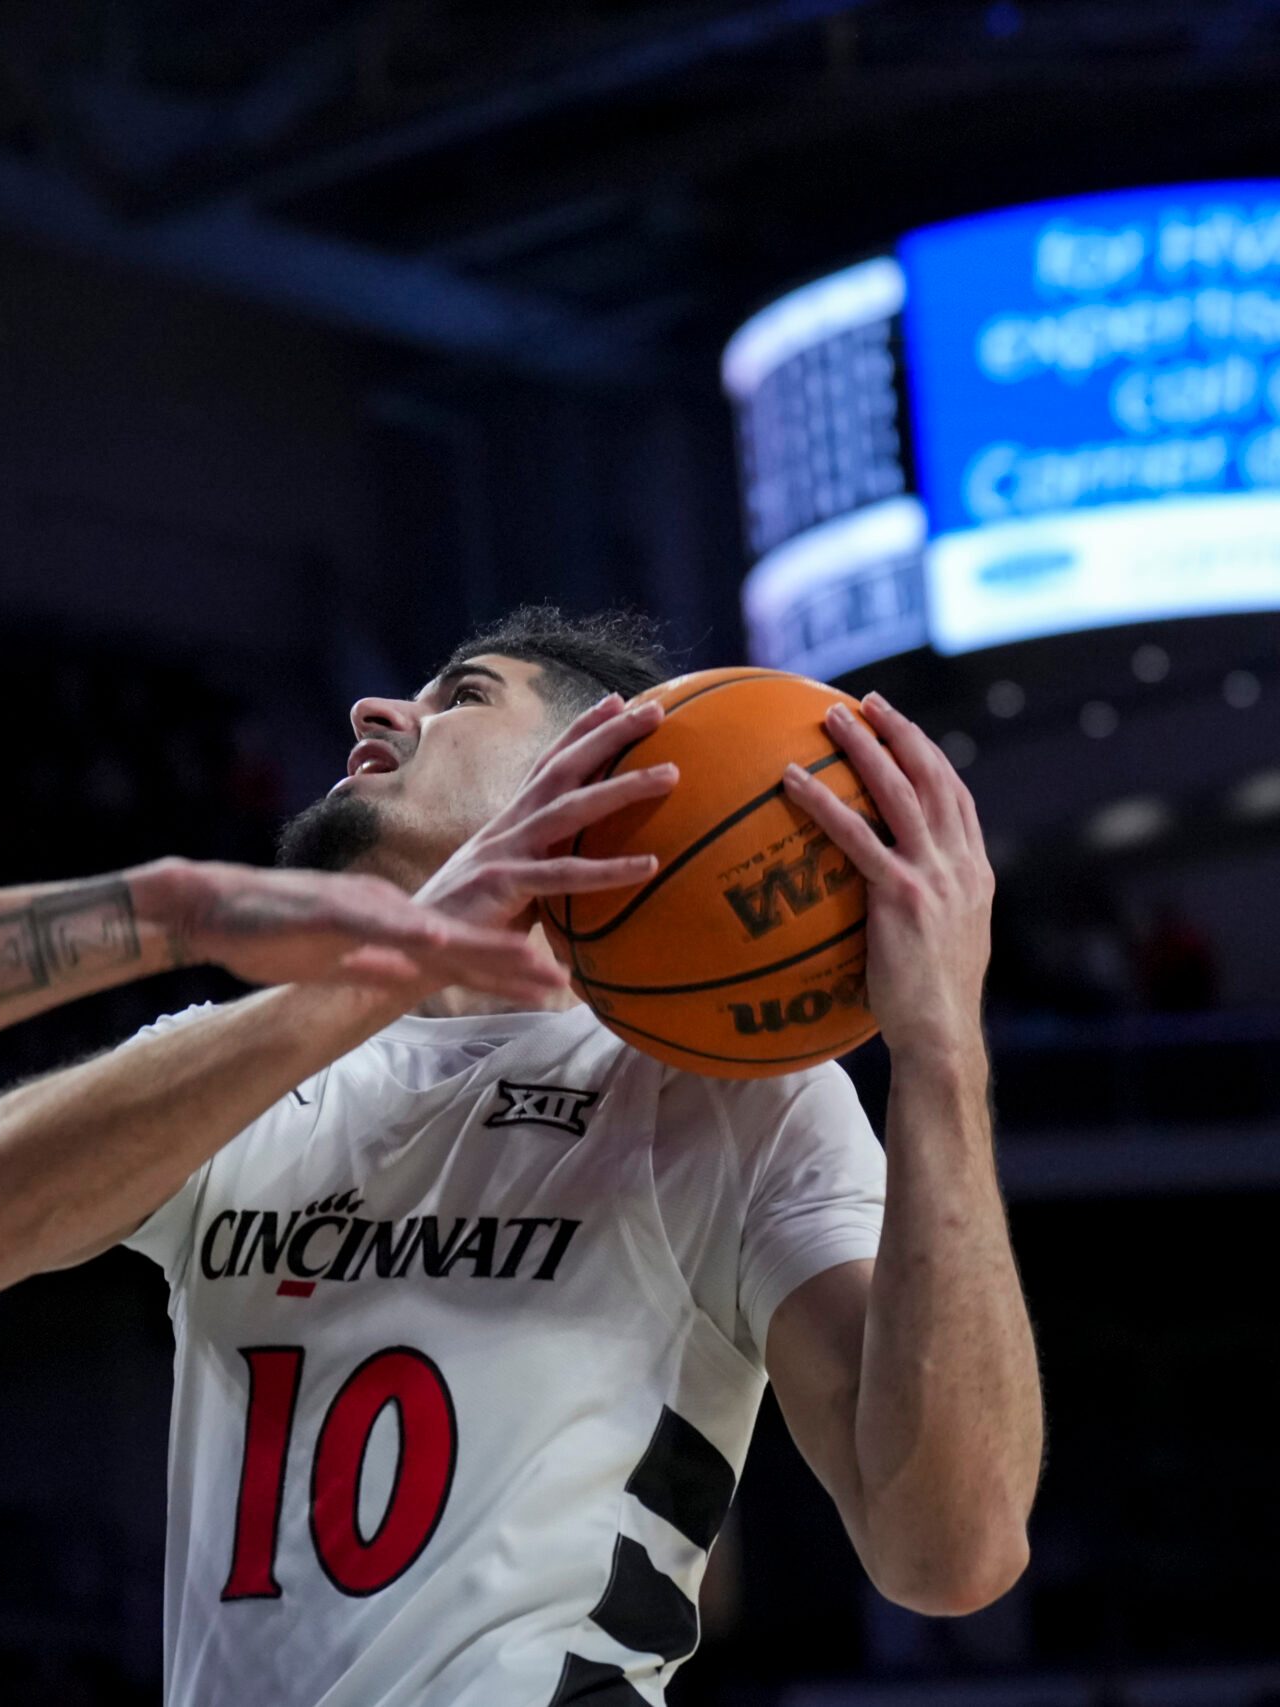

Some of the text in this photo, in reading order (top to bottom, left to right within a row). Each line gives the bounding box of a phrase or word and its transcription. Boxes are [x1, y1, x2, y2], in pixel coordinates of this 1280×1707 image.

[723, 820, 872, 940] CAA
[202, 1209, 582, 1282] CINCINNATI
[222, 1346, 458, 1600] 10
